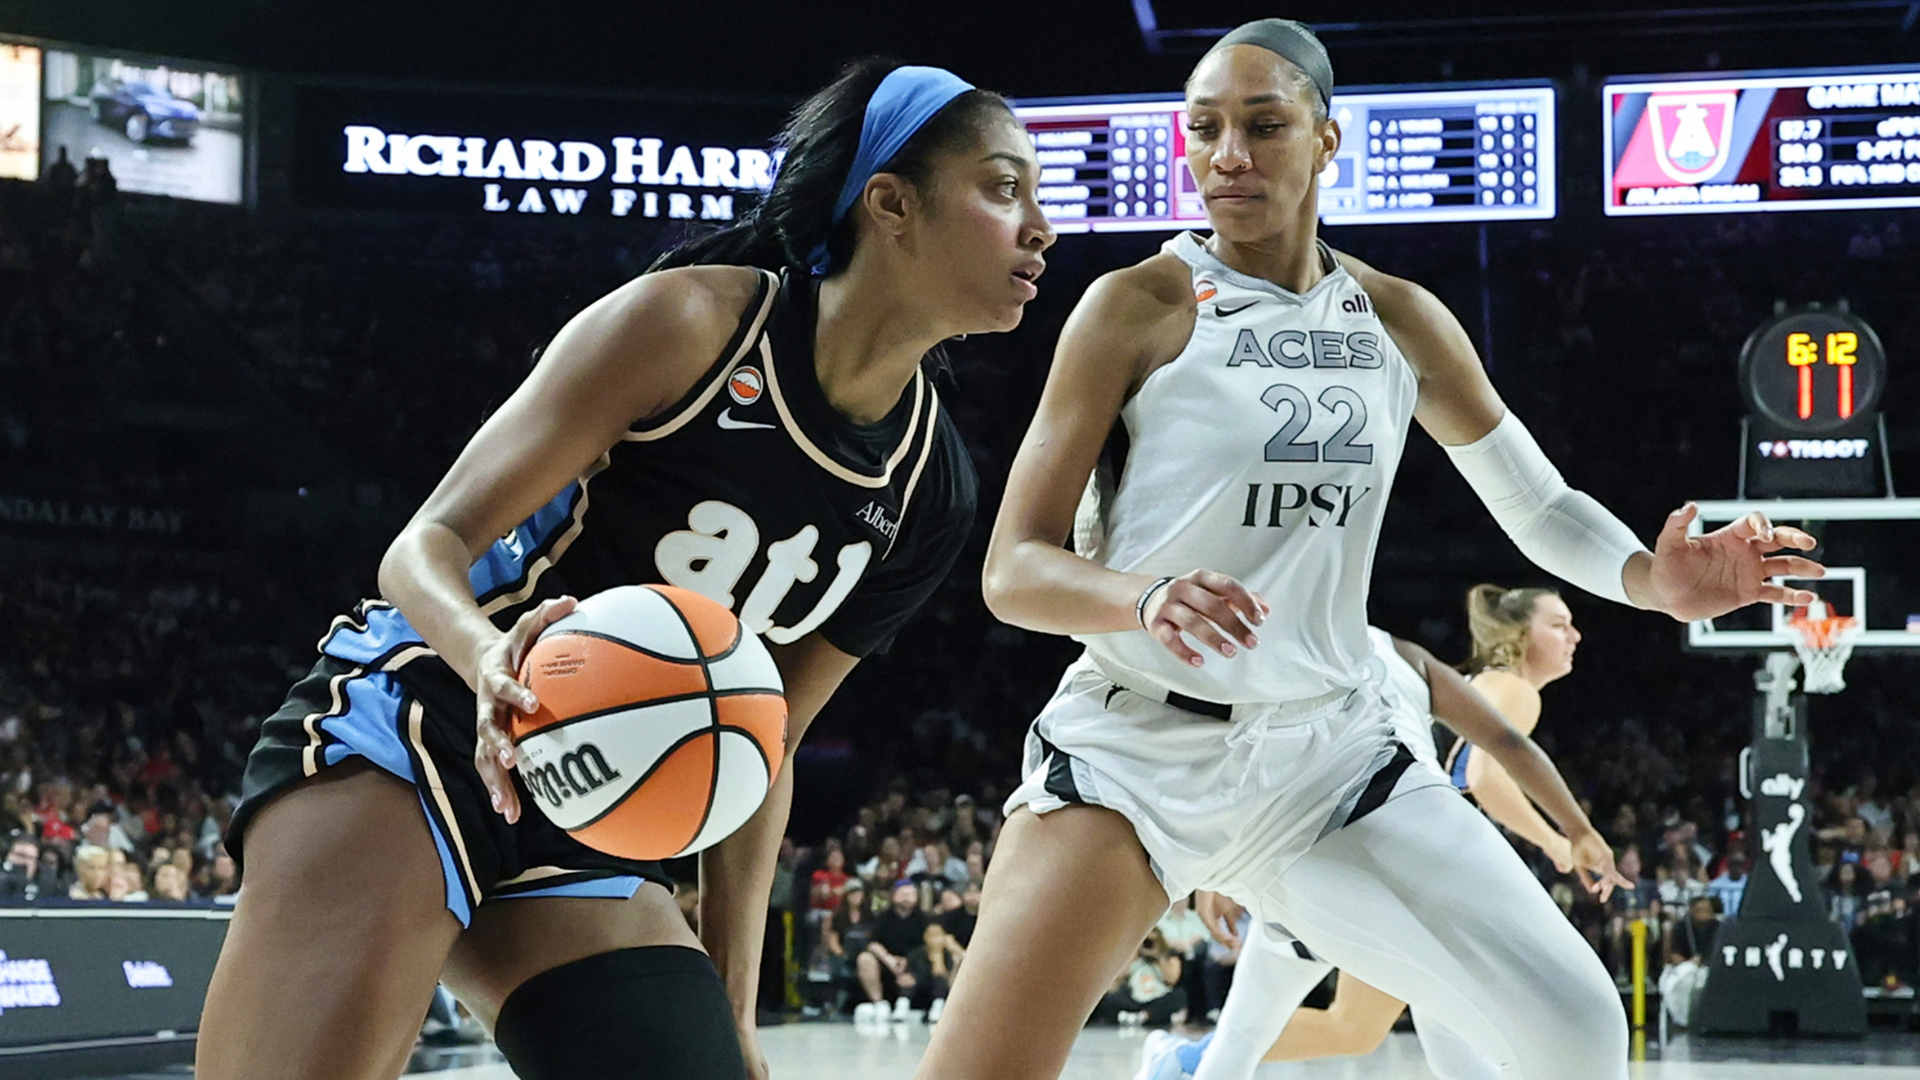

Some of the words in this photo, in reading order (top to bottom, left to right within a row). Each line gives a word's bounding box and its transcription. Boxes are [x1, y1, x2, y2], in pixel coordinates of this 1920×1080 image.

[1807, 86, 1879, 109] GAME
[1881, 83, 1920, 107] MA
[343, 126, 606, 182] RICHARD
[483, 184, 588, 214] LAW
[611, 189, 734, 220] FIRM
[1227, 329, 1383, 369] ACES
[1787, 333, 1857, 365] 6:12
[1260, 383, 1373, 465] 22
[1241, 483, 1371, 527] IPSY
[521, 741, 622, 808] Wils
[1761, 774, 1805, 800] ally
